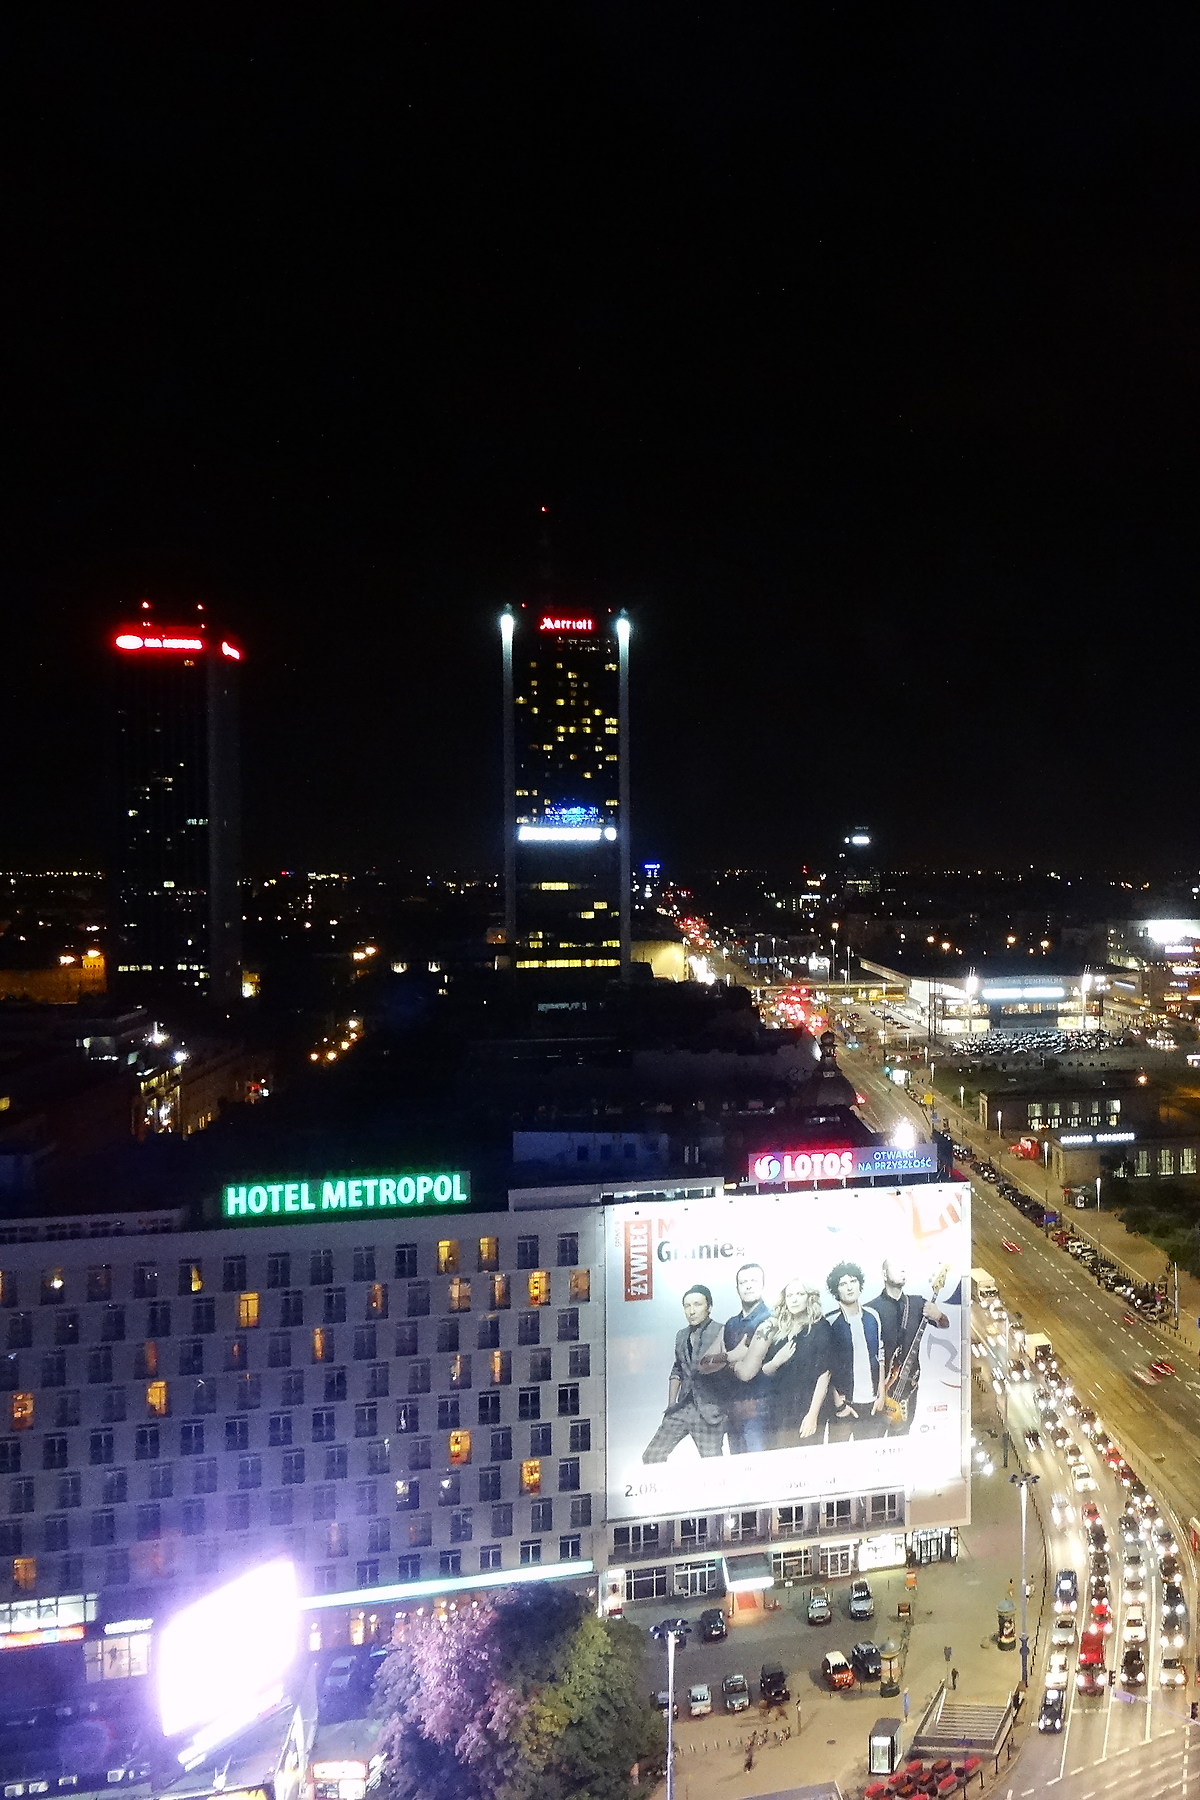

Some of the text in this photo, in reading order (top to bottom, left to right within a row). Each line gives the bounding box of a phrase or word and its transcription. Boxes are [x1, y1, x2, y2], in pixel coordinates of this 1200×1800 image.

[540, 617, 592, 630] Marriott
[784, 1151, 853, 1179] LOTOS
[858, 1157, 932, 1171] NA PRZYSZŁOŚĆ
[873, 1150, 917, 1160] OTWARCI
[227, 1174, 467, 1215] HOTEL METROPOL
[627, 1224, 648, 1295] ŻYWIEC
